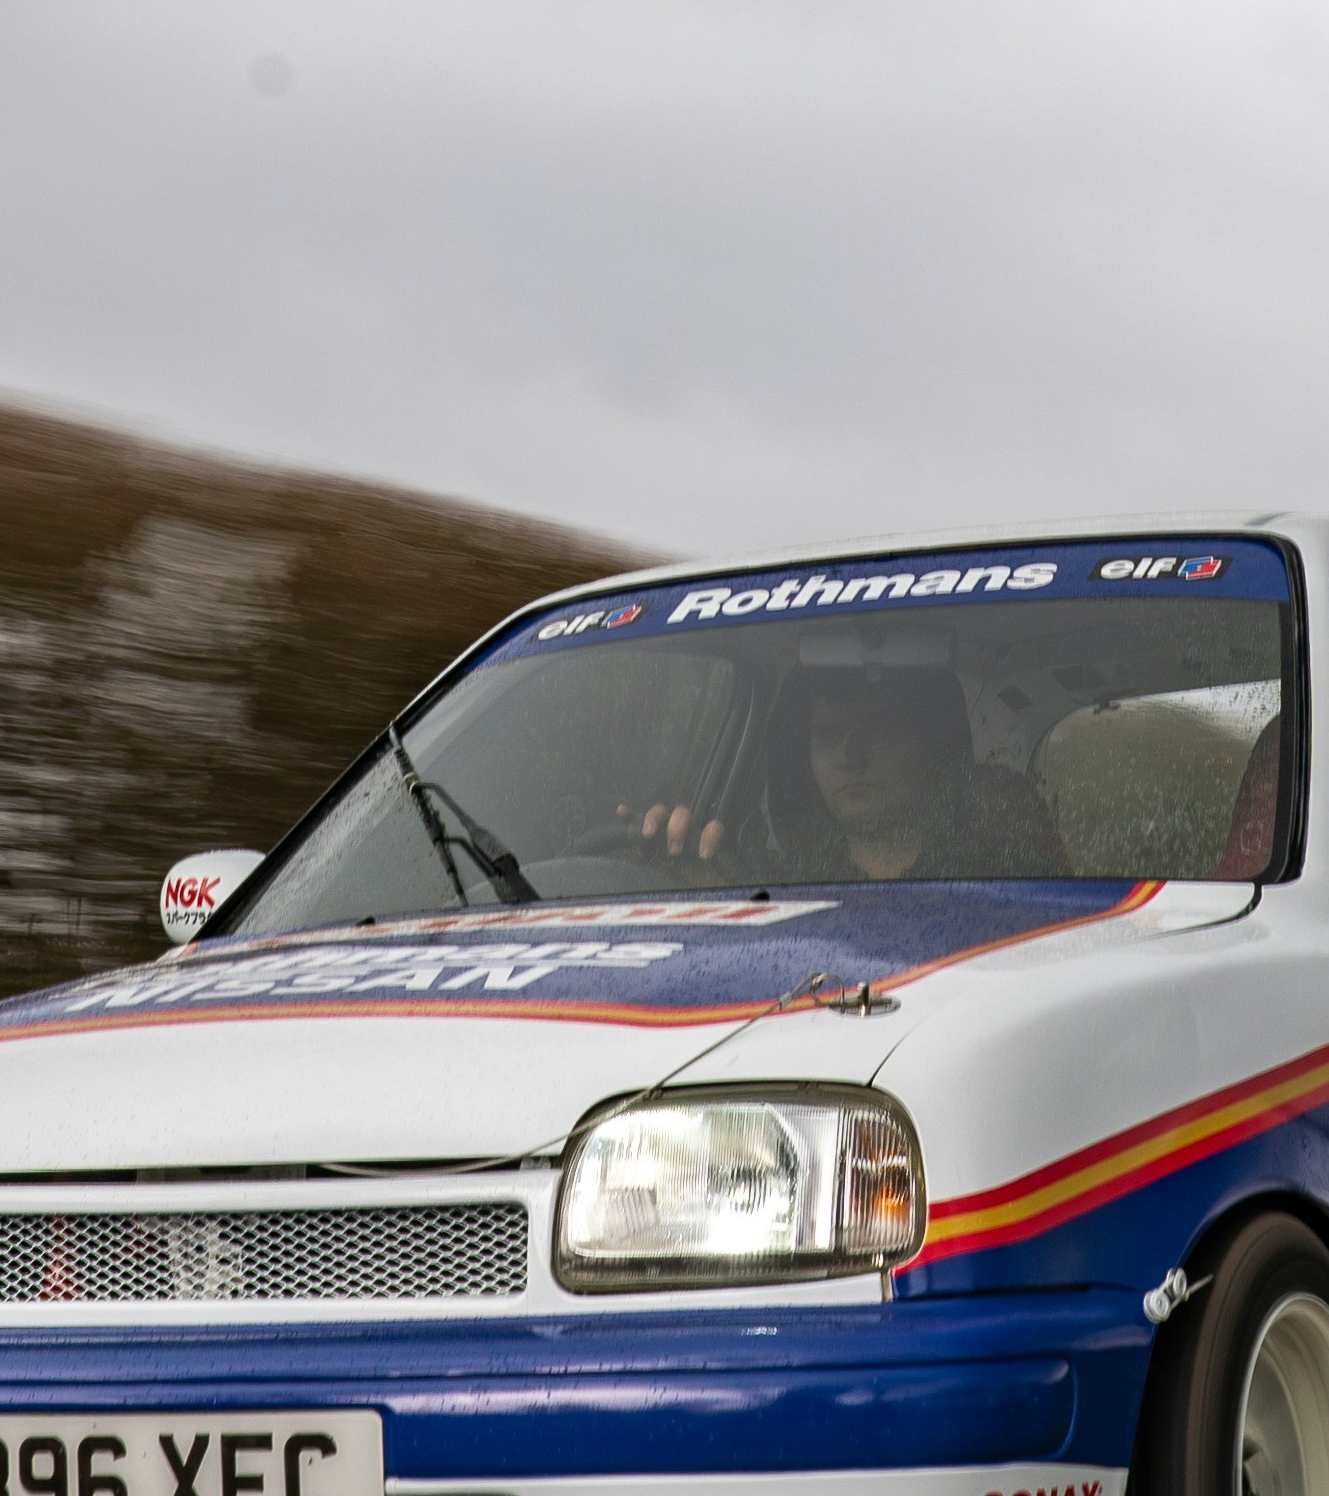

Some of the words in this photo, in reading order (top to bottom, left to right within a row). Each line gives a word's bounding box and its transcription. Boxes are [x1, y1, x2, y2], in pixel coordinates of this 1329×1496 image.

[1100, 557, 1177, 579] elf
[667, 562, 1059, 625] Rothmans
[538, 611, 605, 640] elf
[165, 877, 221, 909] NGK
[63, 964, 561, 1014] NISSAN
